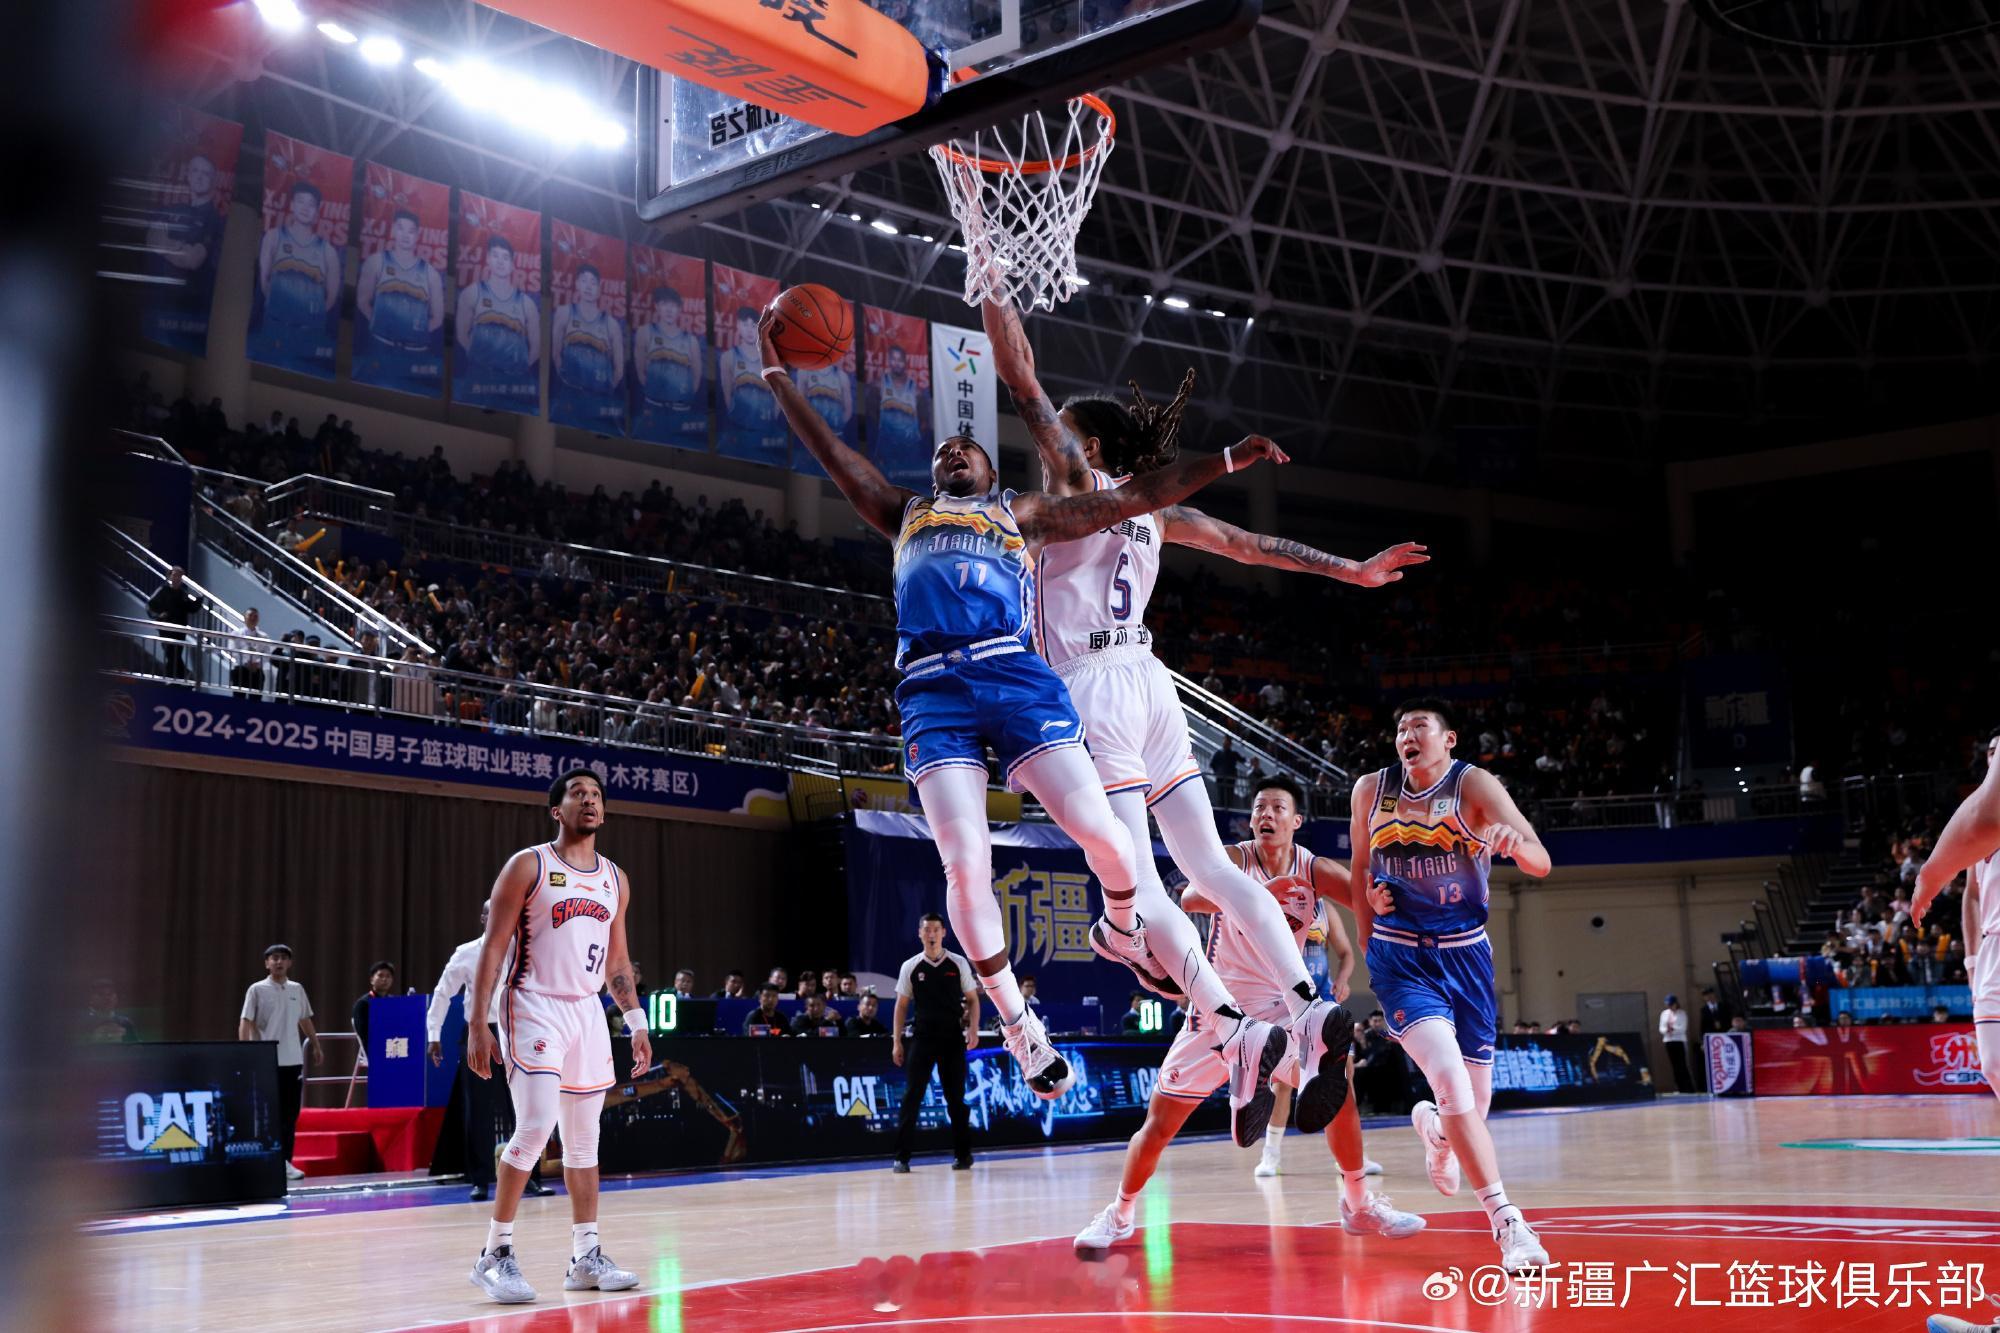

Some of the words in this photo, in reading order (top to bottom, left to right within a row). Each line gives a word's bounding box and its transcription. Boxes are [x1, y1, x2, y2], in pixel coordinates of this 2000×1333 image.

[954, 561, 988, 591] 77
[1110, 552, 1132, 621] 5
[153, 705, 319, 751] 2024-2025
[551, 897, 611, 929] SHARKS
[1438, 882, 1463, 905] 13
[585, 943, 606, 975] 51
[649, 992, 678, 1031] 10
[833, 1075, 879, 1117] CAT
[124, 1091, 214, 1152] CAT
